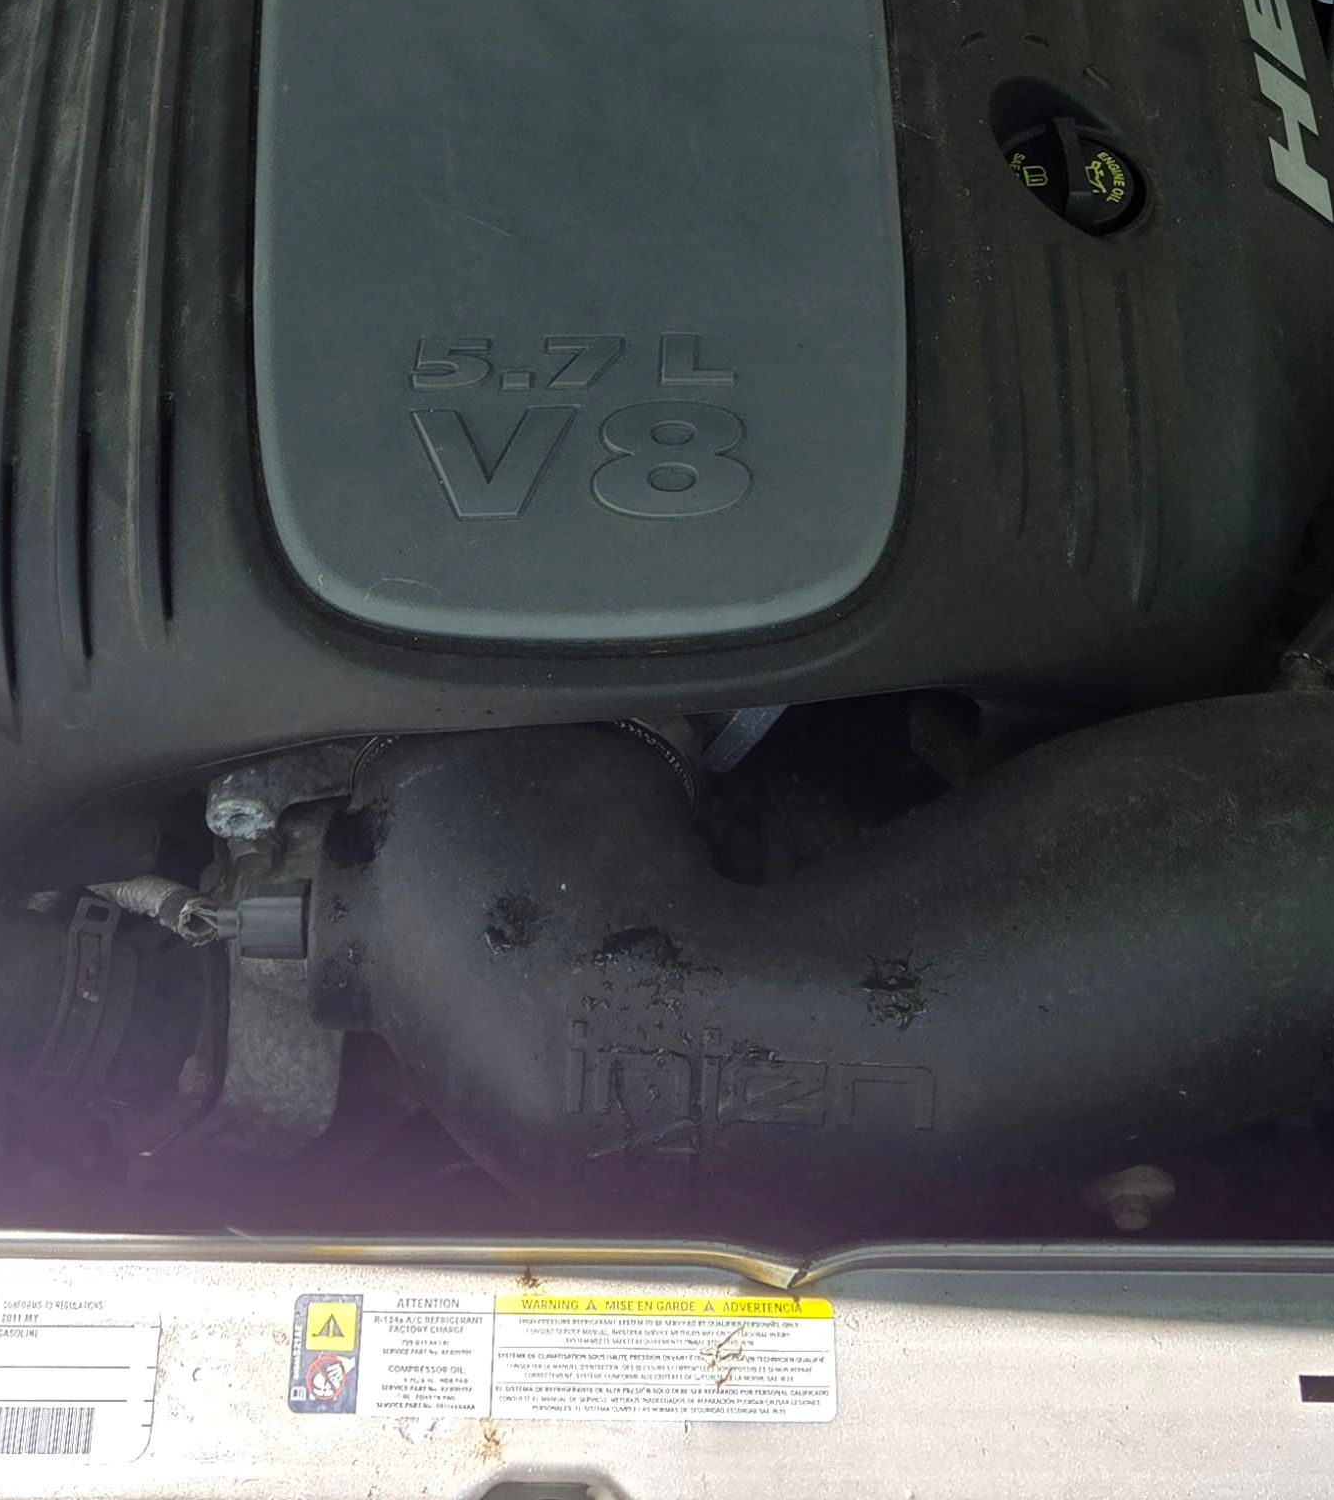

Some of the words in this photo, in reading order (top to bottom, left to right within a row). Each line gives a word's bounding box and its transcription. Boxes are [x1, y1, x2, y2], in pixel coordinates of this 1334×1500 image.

[1010, 152, 1025, 171] SAE
[1097, 151, 1126, 187] ENGINE
[1106, 187, 1125, 203] OIL
[409, 399, 754, 521] V8
[396, 1298, 460, 1308] ATTENTION
[521, 1299, 579, 1310] WARNING
[605, 1300, 633, 1311] MISE
[637, 1301, 653, 1311] EN
[656, 1301, 696, 1312] GARDE
[723, 1302, 802, 1314] ADVERTENCIA
[1, 1313, 21, 1323] 2011
[24, 1313, 39, 1323] MY
[405, 1316, 422, 1324] A/C
[425, 1316, 483, 1325] REFRIGERANT
[389, 1325, 428, 1333] FACTORY
[430, 1326, 464, 1334] CHARGE
[388, 1365, 448, 1374] COMPRESSOR
